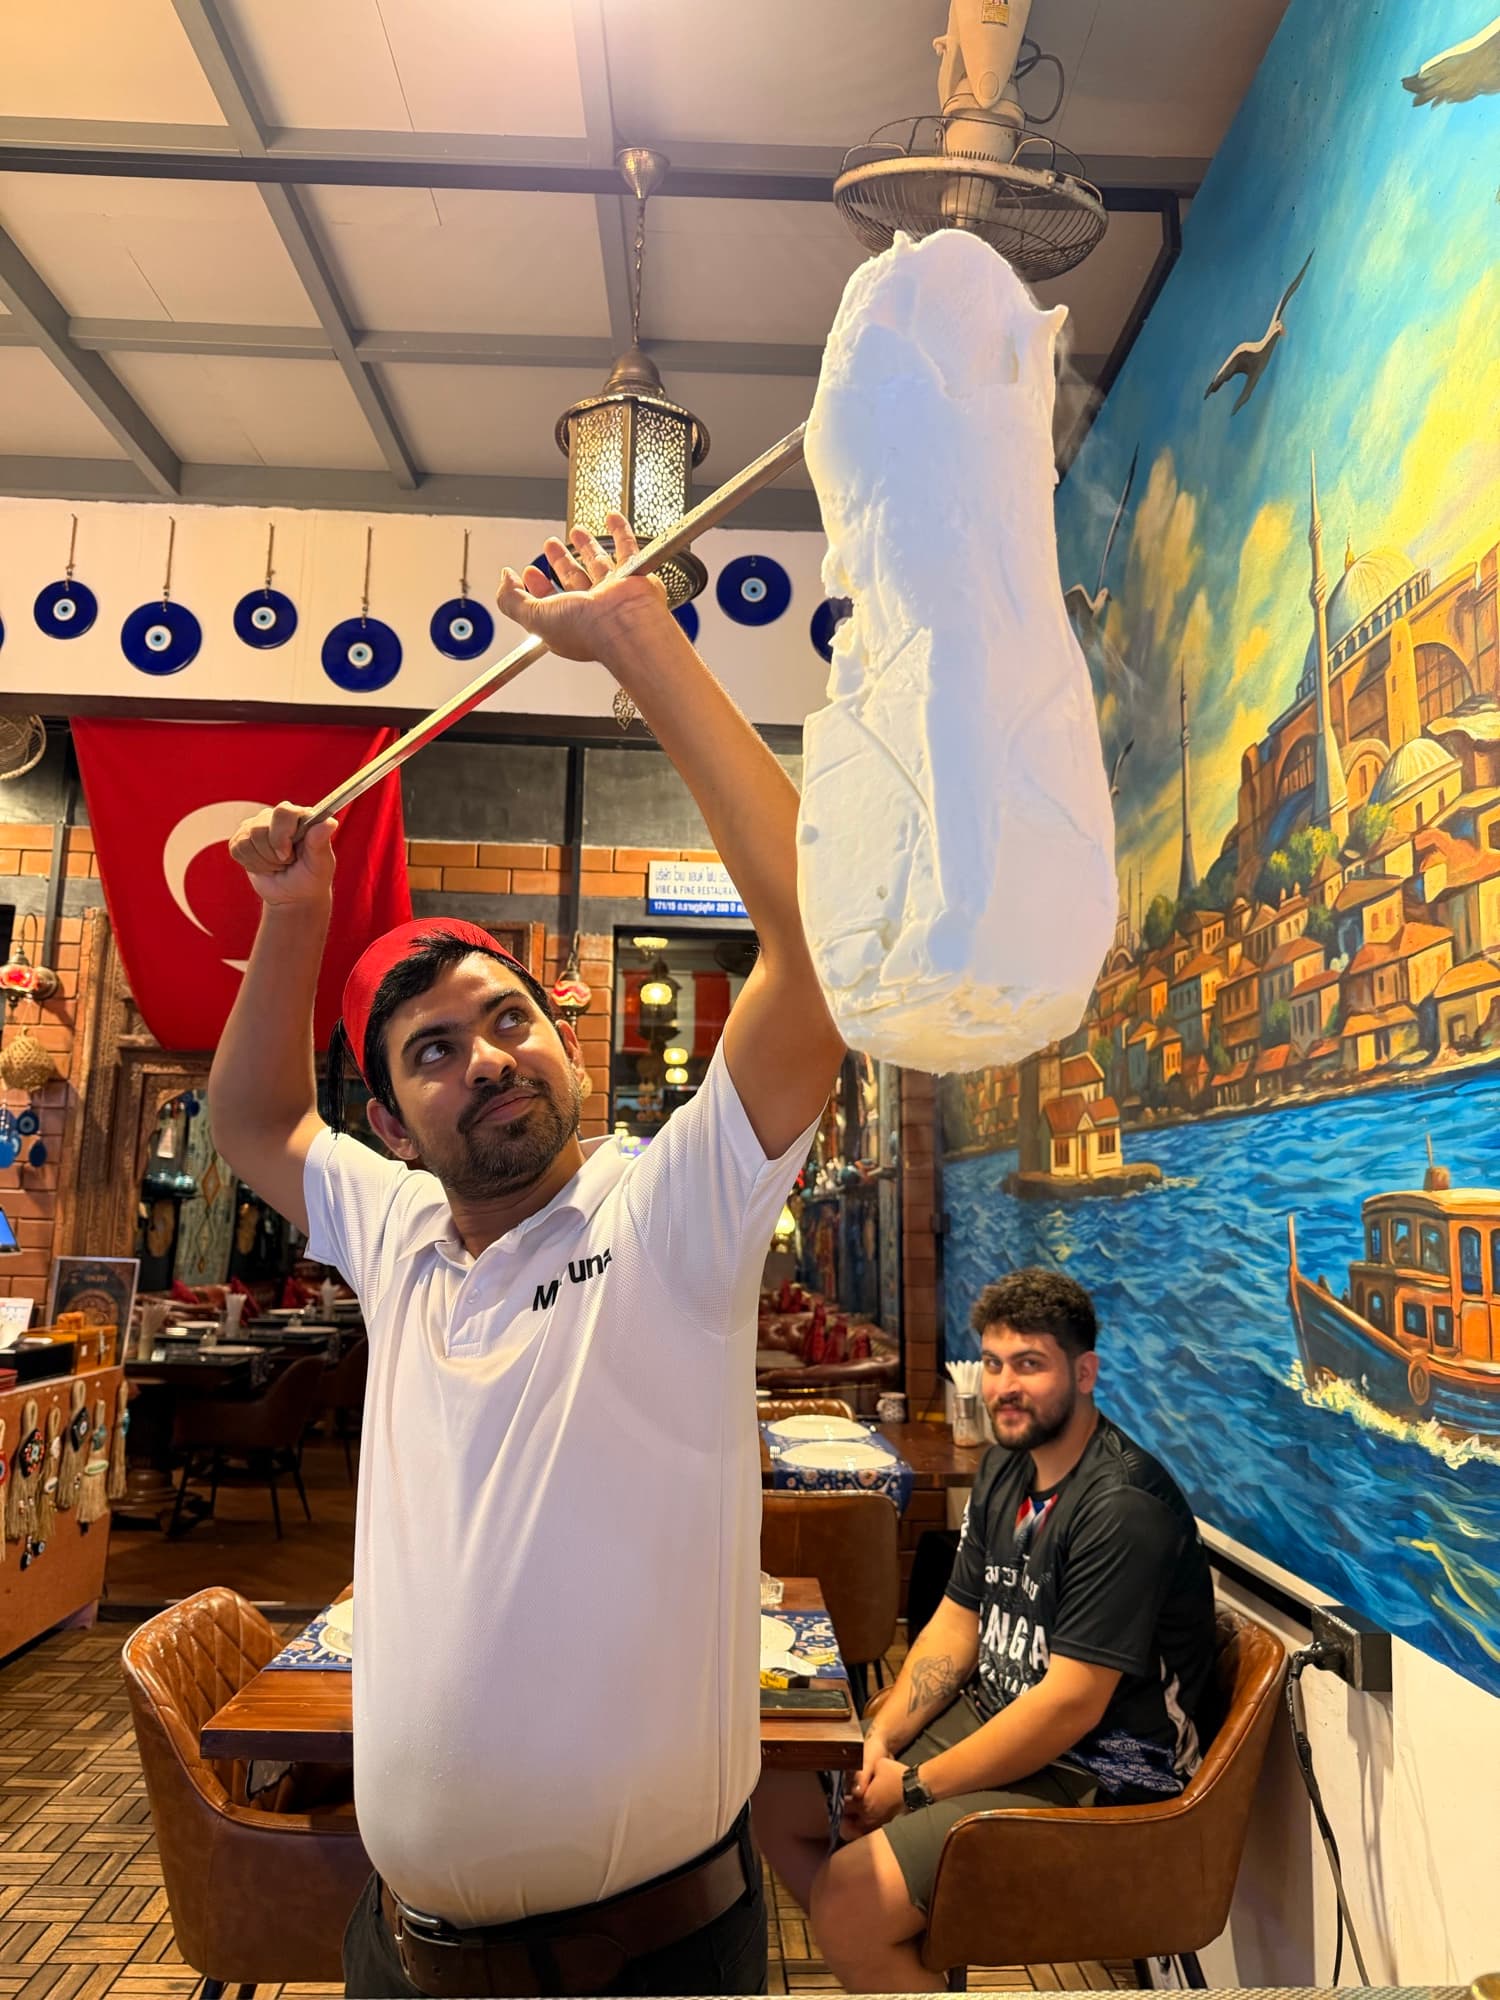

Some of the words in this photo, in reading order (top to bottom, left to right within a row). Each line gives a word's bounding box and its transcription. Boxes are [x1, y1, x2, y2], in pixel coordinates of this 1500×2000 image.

[655, 885, 672, 894] VIBE
[680, 885, 696, 895] FINE
[697, 886, 738, 896] RESTAURAN
